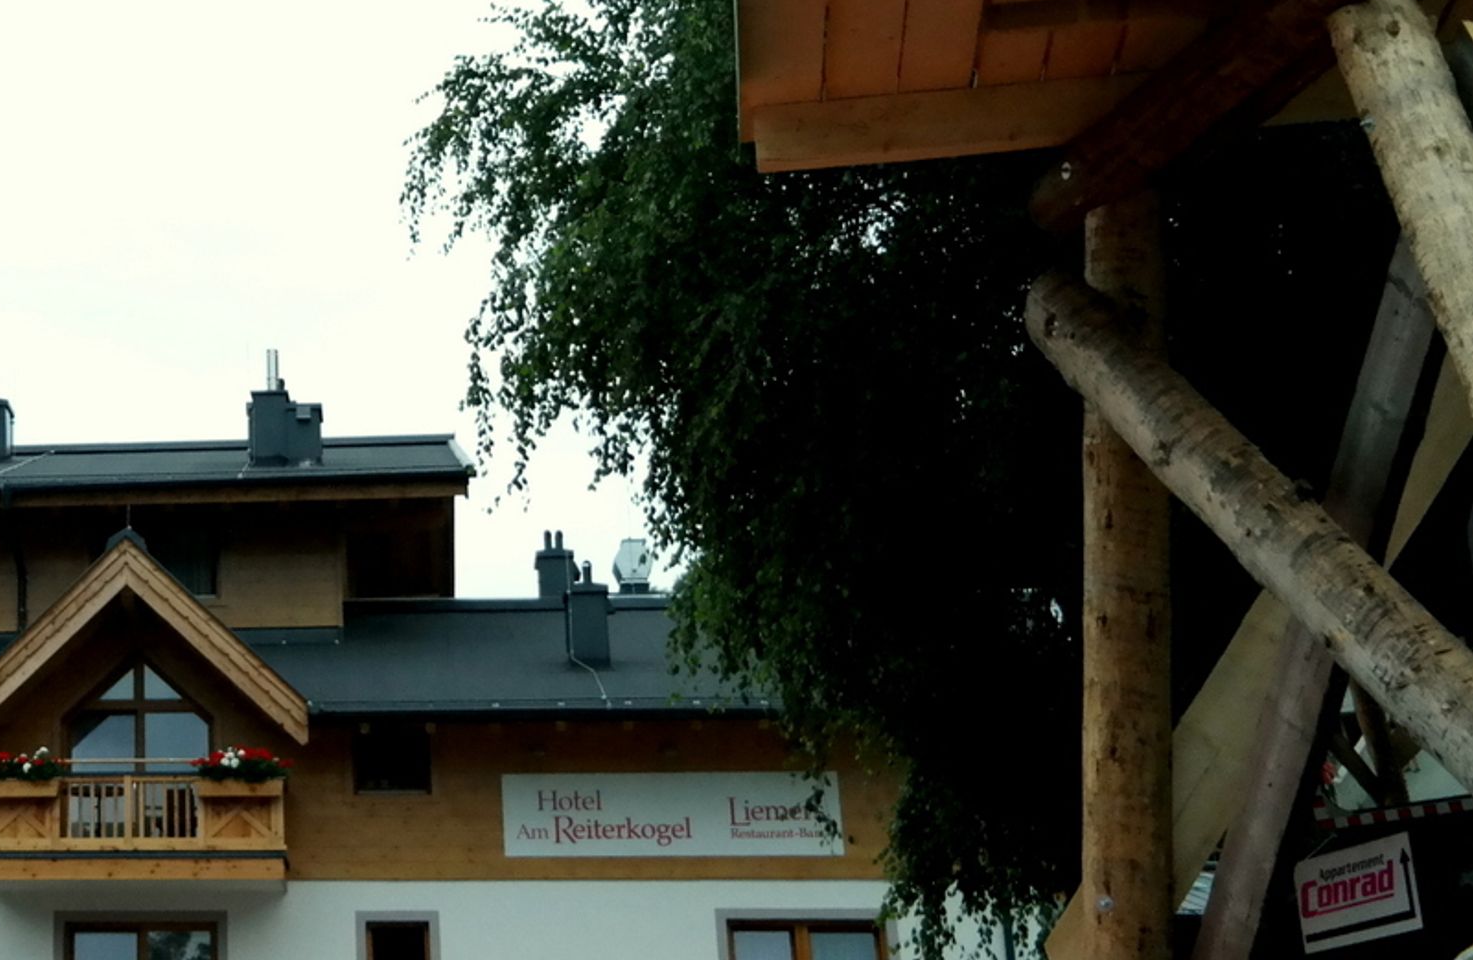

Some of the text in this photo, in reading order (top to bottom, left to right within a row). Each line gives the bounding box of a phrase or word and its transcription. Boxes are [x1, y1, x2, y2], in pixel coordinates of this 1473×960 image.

[537, 789, 602, 812] Hotel
[516, 815, 693, 846] Am Reiterkogel
[1301, 859, 1394, 918] Conrad
